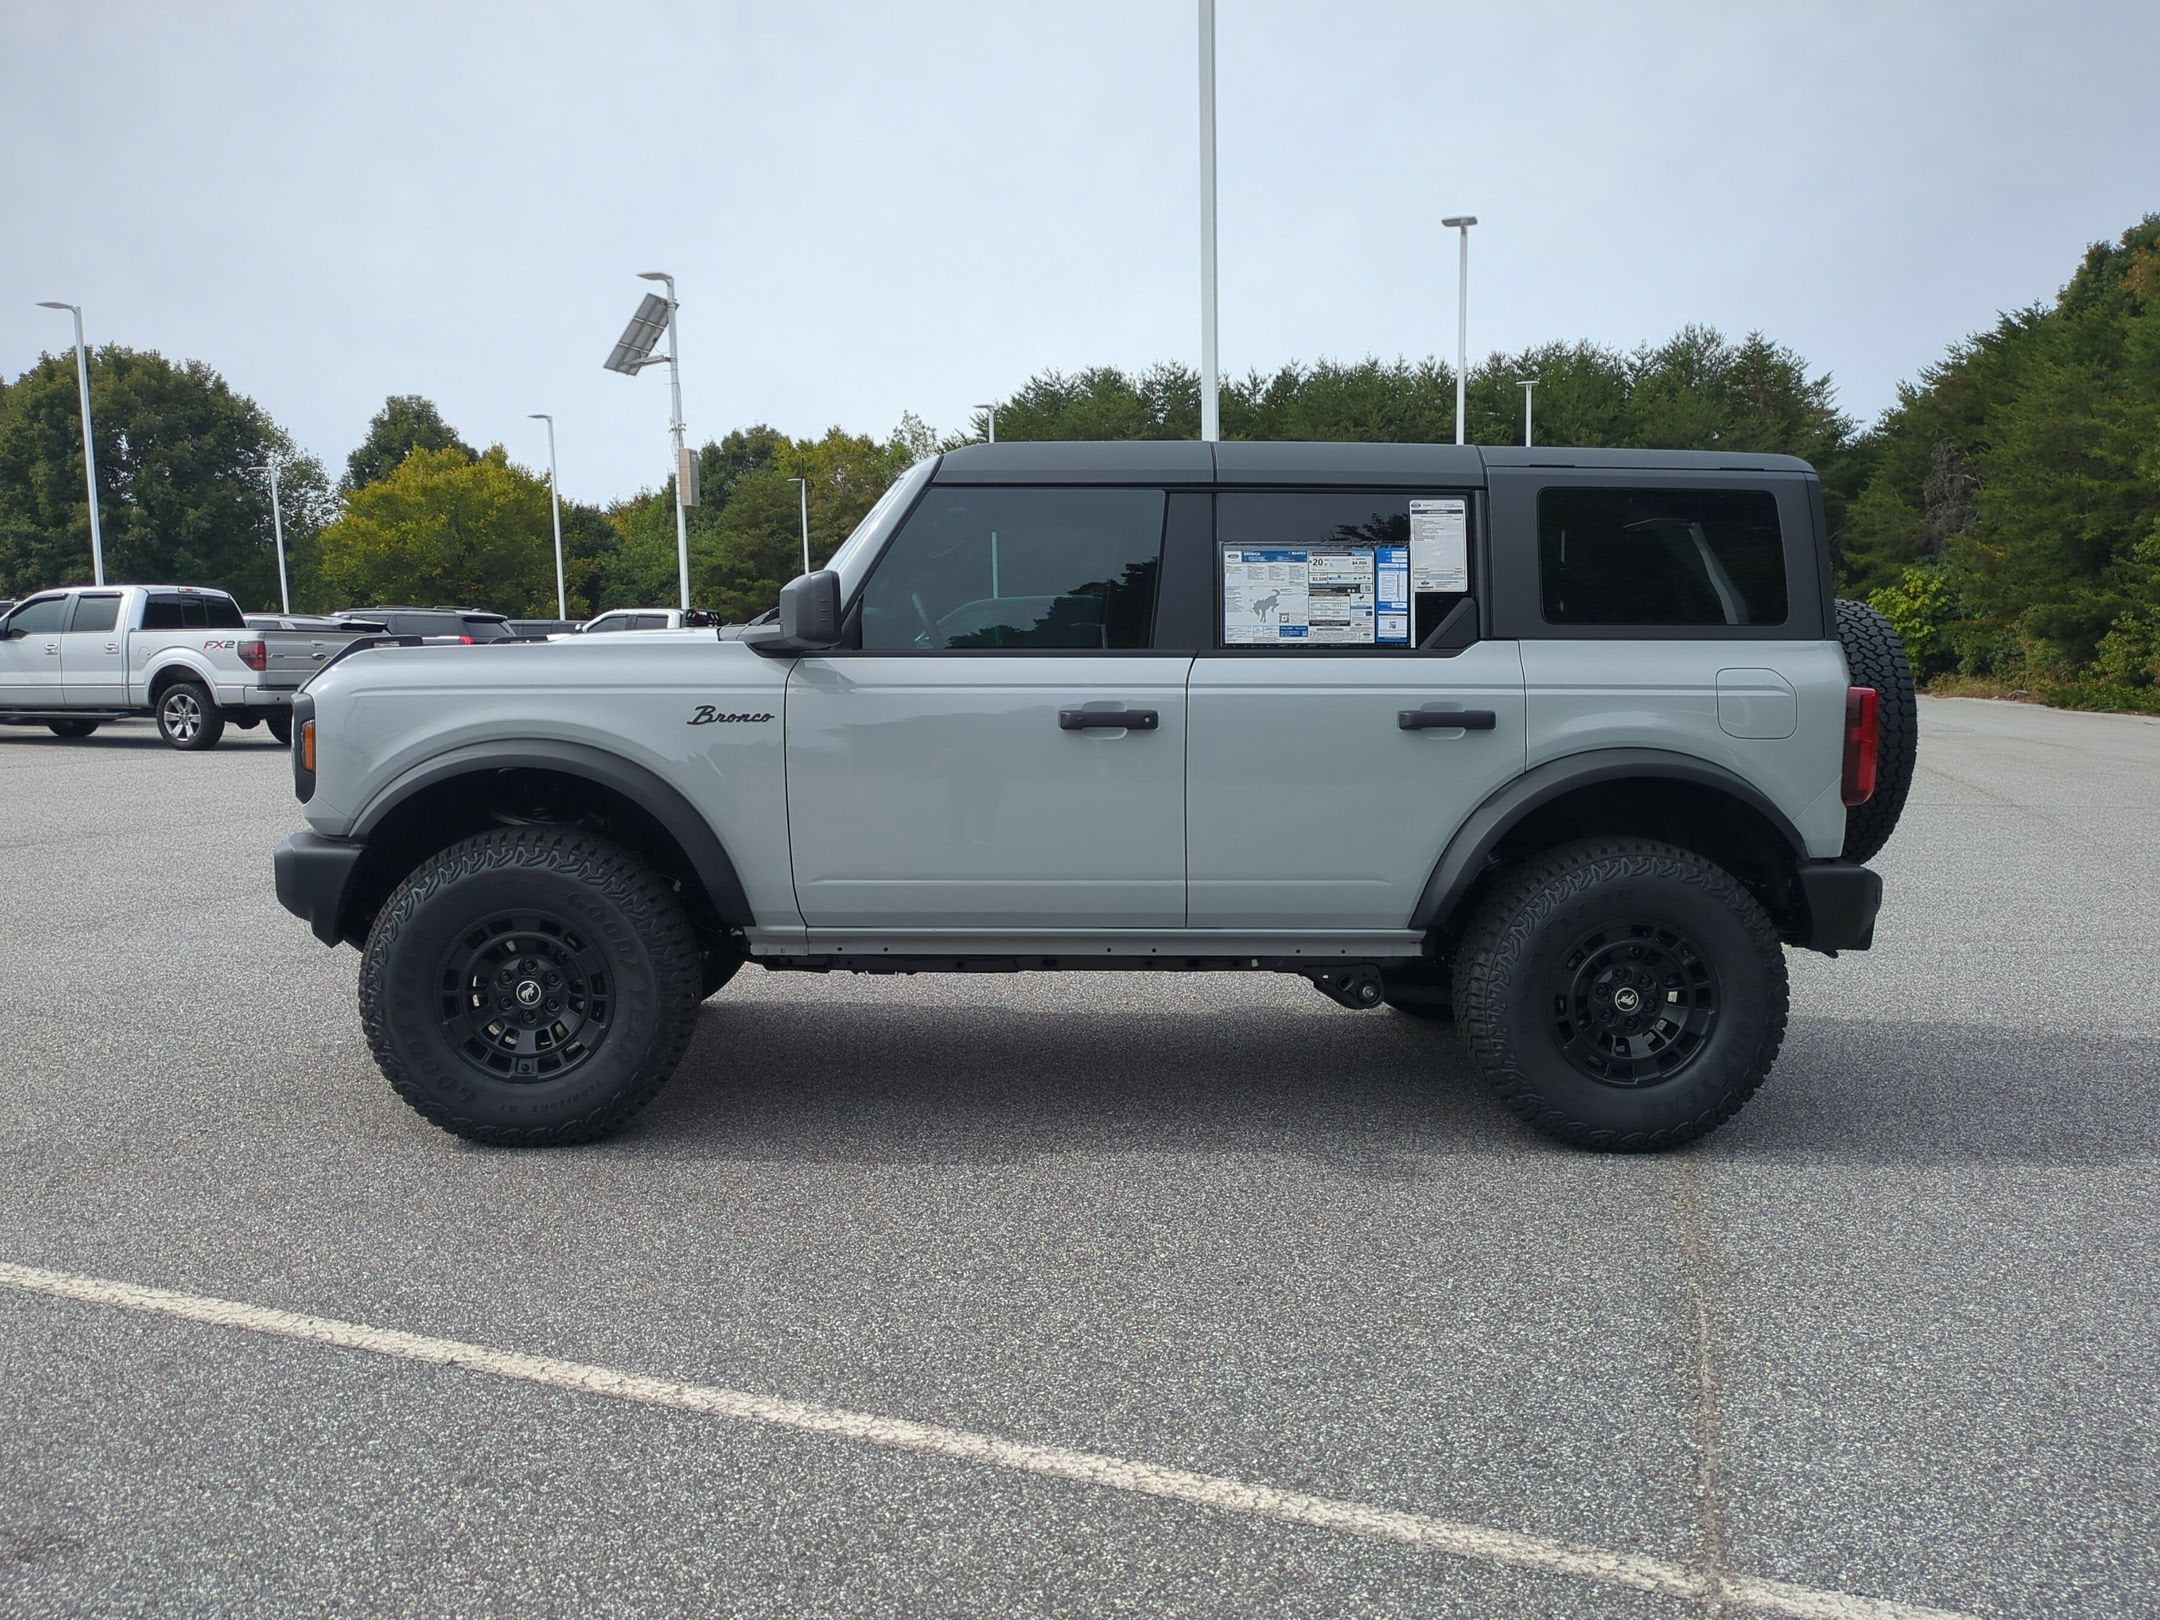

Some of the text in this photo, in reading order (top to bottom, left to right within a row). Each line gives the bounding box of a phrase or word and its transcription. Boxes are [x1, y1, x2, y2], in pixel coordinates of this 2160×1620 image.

[1312, 558, 1323, 566] 20
[203, 640, 236, 649] FX2
[686, 704, 776, 726] Bronco
